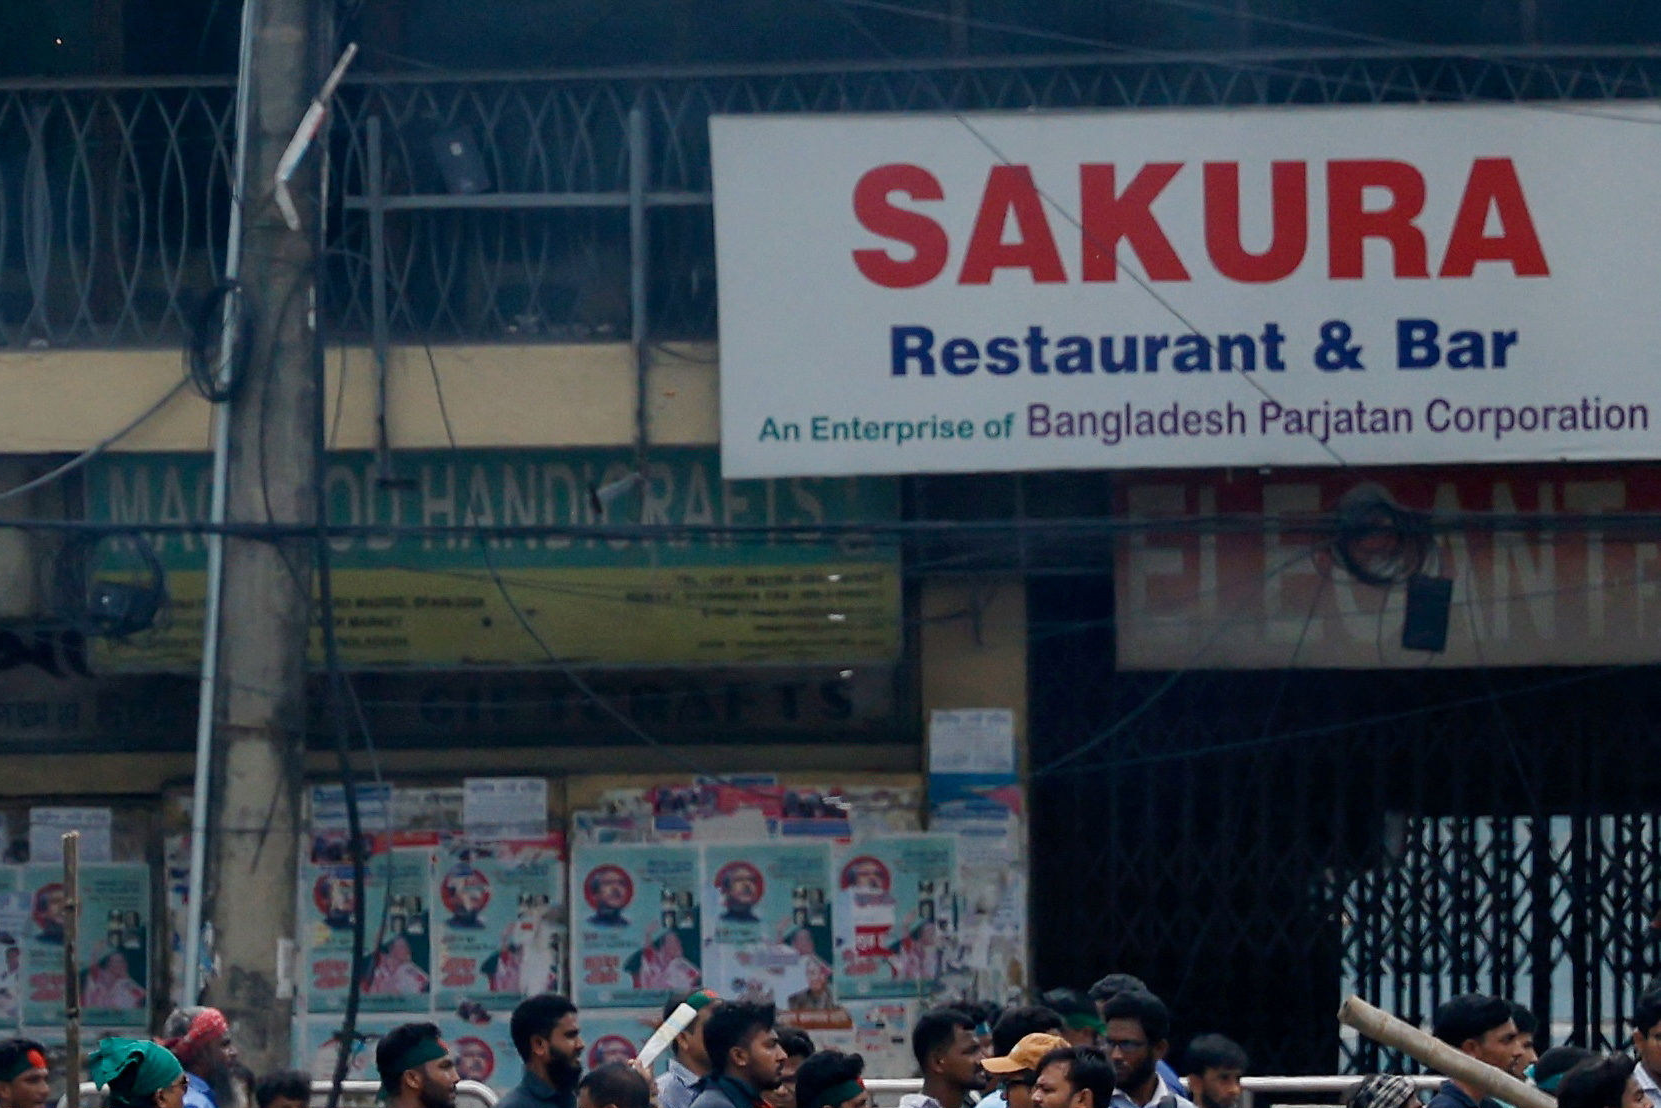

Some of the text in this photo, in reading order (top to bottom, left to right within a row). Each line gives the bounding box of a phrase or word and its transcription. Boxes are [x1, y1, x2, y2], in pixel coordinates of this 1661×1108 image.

[852, 157, 1551, 289] SAKURA
[889, 318, 1519, 377] Restaurant & Bar
[758, 395, 1650, 447] An Enterprise of Bangladesh Parjatan Corporation
